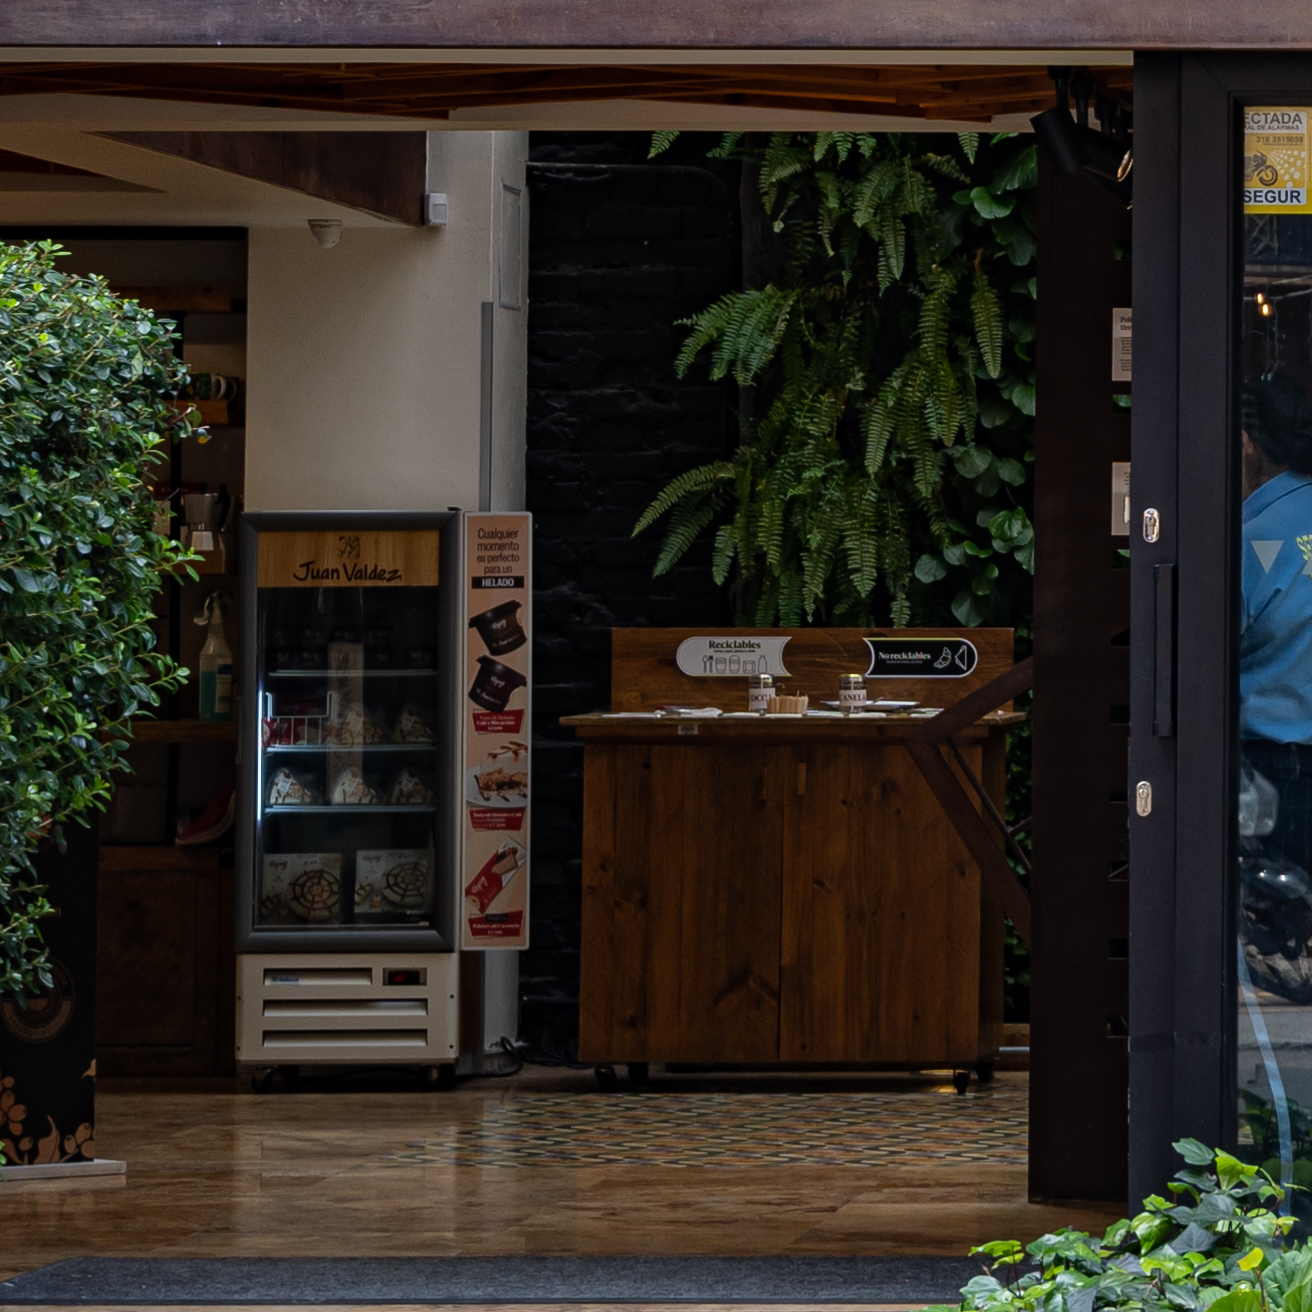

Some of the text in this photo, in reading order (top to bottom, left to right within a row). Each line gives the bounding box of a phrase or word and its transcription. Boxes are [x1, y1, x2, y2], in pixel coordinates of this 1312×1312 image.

[478, 528, 519, 541] Cualquier
[477, 542, 519, 551] momento
[477, 552, 520, 564] es perfecto
[293, 561, 403, 583] Juan Valdez
[483, 565, 512, 575] para un
[482, 578, 514, 586] HELADO
[708, 640, 762, 649] Reciclables
[878, 651, 932, 660] No reciclables
